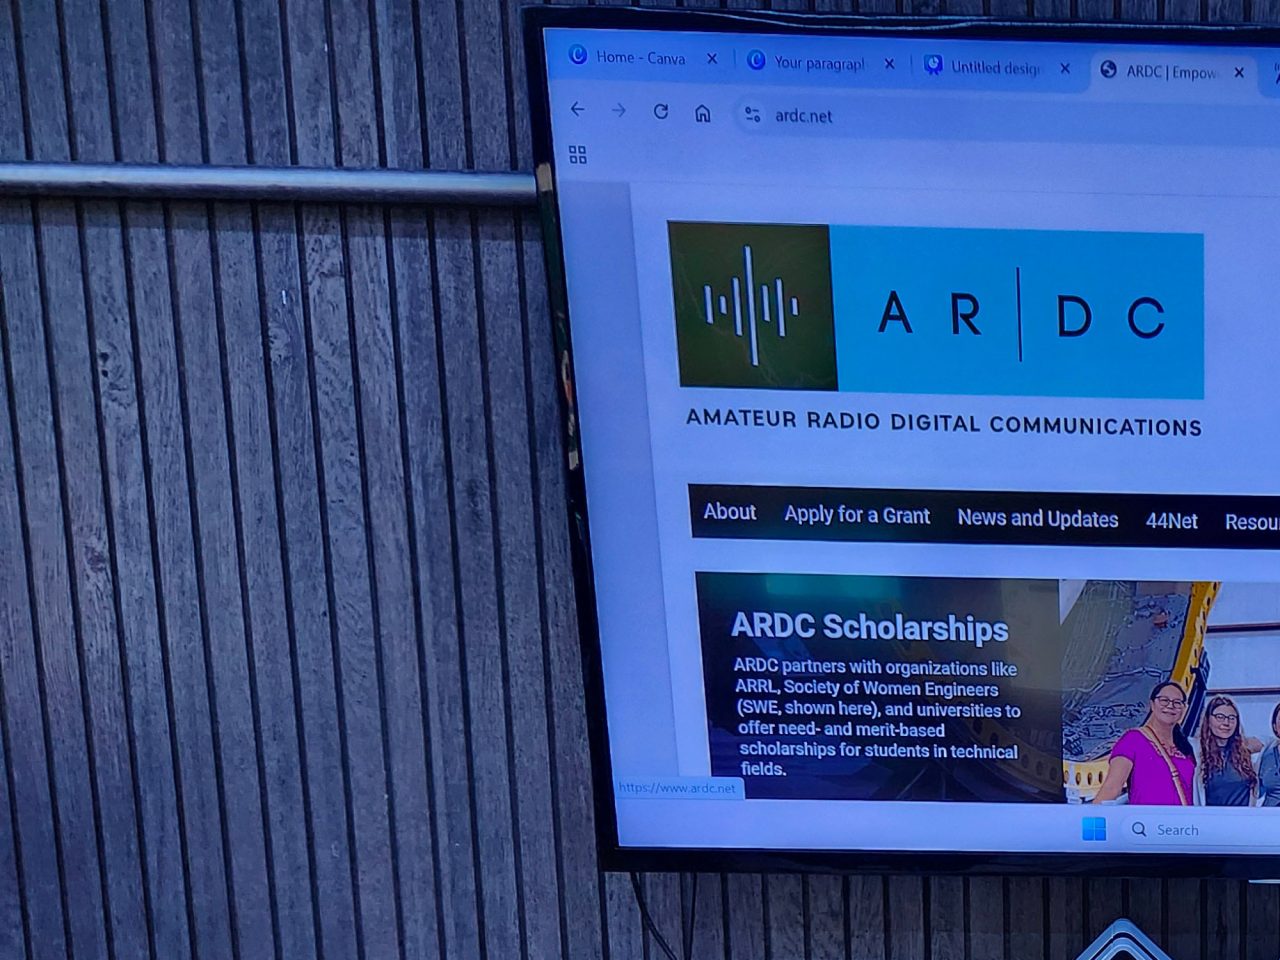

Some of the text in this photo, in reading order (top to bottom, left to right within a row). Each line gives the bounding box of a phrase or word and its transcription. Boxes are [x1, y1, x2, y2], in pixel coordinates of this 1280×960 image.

[597, 51, 635, 64] Home
[648, 51, 686, 66] Canva
[775, 54, 801, 69] Your
[951, 59, 1000, 75] Untitled
[1126, 66, 1163, 79] ARDC
[775, 107, 834, 124] ardc.net
[686, 408, 1202, 437] AMATEUR RADIO DIGITAL COMMUNICATIONS
[703, 502, 757, 521] About
[784, 504, 931, 526] Apply for a Grant
[957, 508, 1119, 530] News and Updates
[1146, 512, 1199, 530] 44Net
[731, 611, 1009, 648] ARDC Scholarships
[734, 657, 1018, 679] ARDC partners with organizations like
[735, 679, 999, 700] ARRL, Society of Women Engineers
[736, 700, 1022, 719] (SWE, shown here), and universities to
[738, 720, 946, 738] offer need- and merit-based
[739, 741, 1019, 760] scholarships for students in technical
[741, 761, 788, 777] fields.
[618, 779, 737, 796] https://www.ardc.net
[1157, 824, 1200, 837] Search
